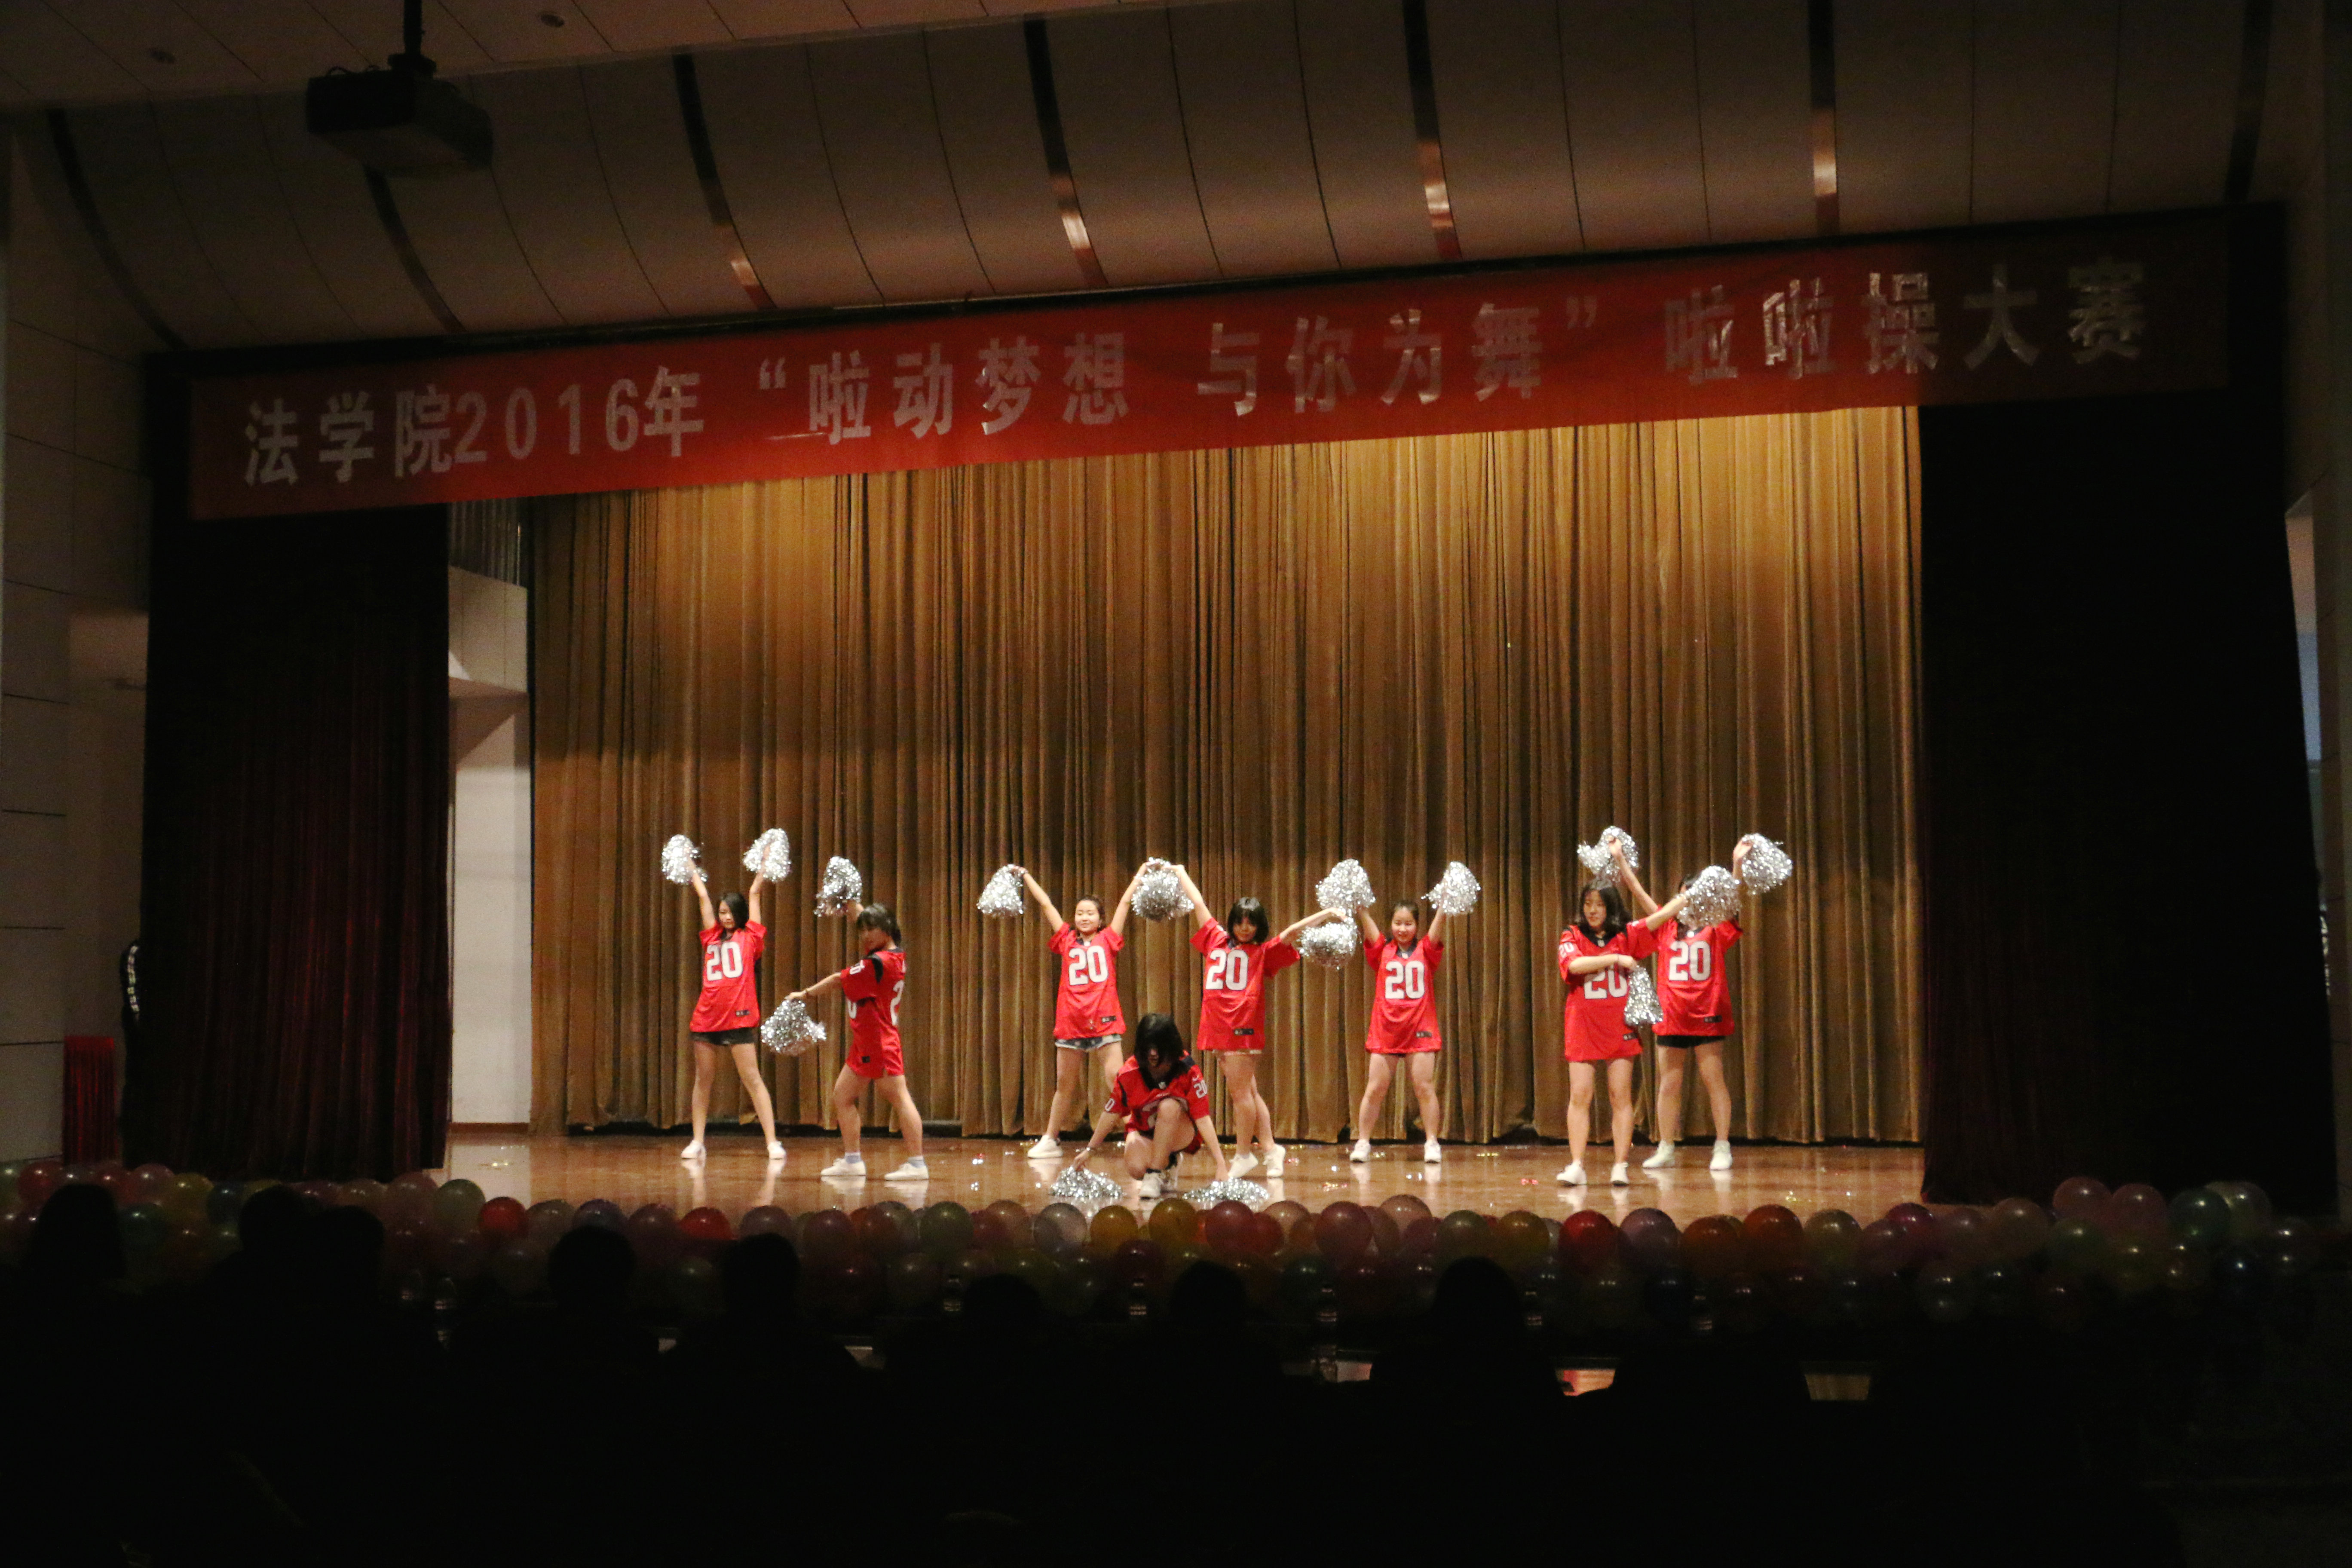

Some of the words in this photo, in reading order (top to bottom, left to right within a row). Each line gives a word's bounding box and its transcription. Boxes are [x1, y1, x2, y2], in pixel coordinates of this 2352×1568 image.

[243, 365, 704, 487] 法学院2016年
[1665, 259, 2147, 385] 啦啦操大赛
[706, 941, 743, 981] 20
[1069, 945, 1109, 986] 20
[1206, 949, 1249, 990] 20
[1559, 942, 1574, 958] 20
[1669, 940, 1710, 981] 20
[1385, 961, 1425, 1000] 20
[1584, 966, 1628, 999] 20
[1194, 1079, 1208, 1099] 20
